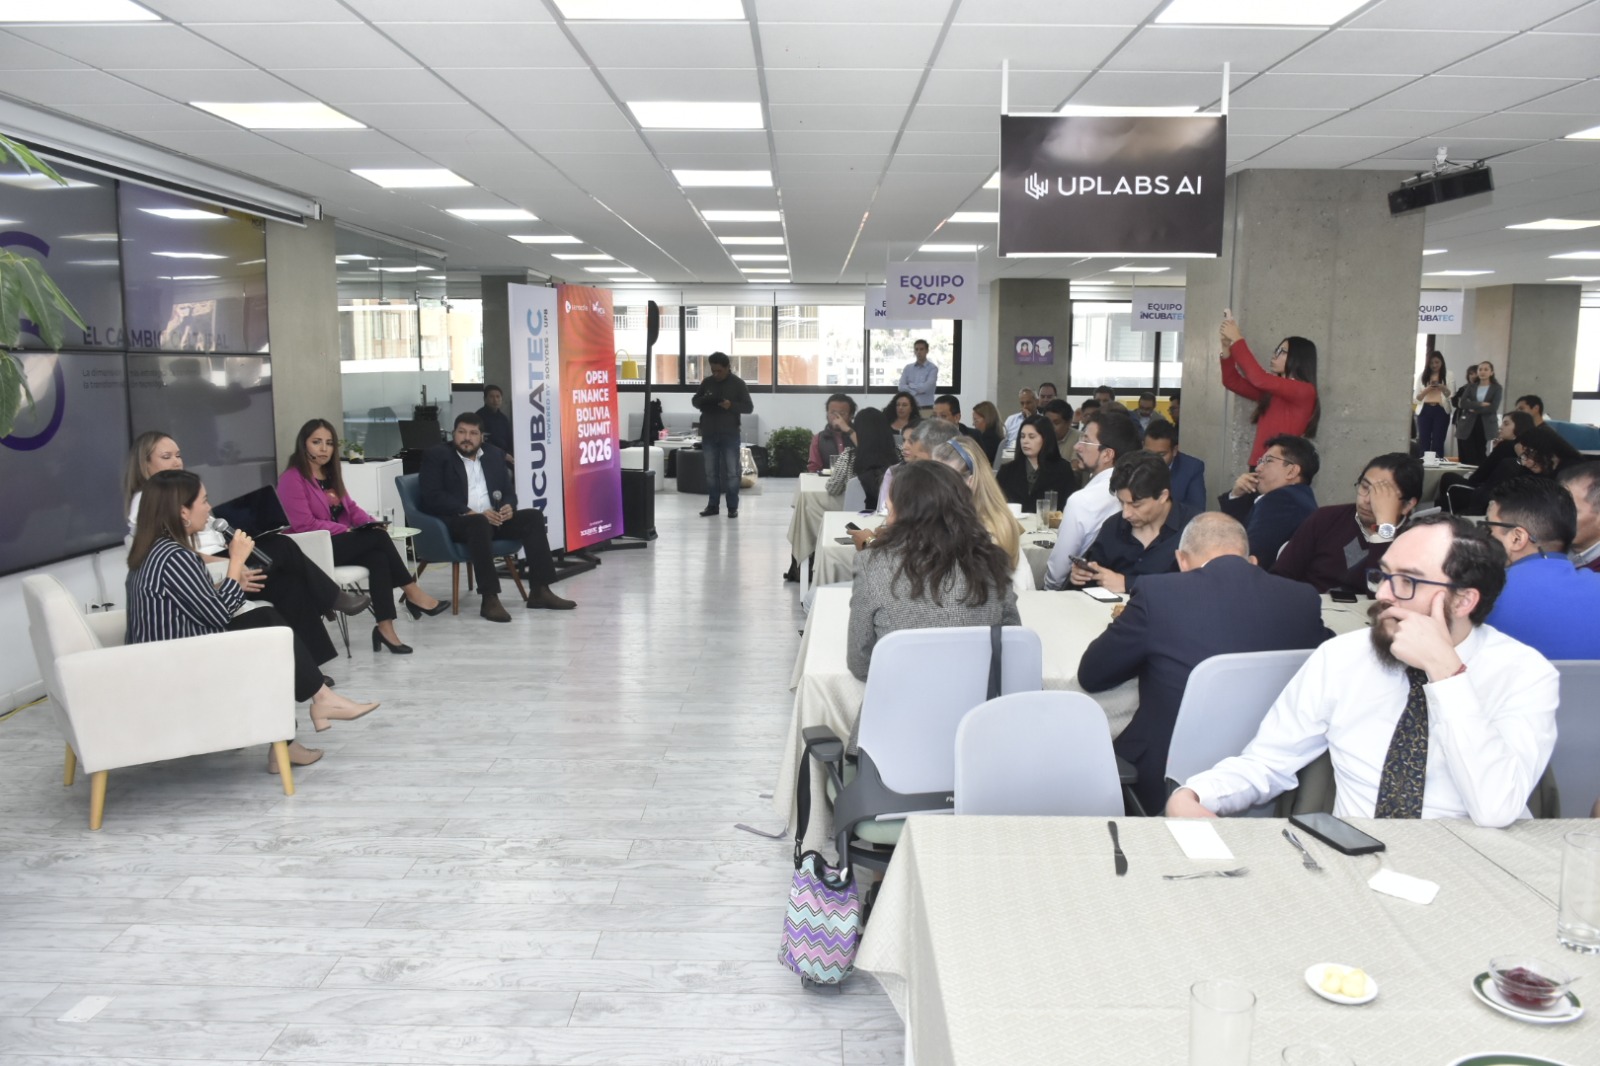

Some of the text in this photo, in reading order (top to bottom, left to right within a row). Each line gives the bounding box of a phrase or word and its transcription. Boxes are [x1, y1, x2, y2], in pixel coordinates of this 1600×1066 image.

[1057, 175, 1203, 196] UPLABS AI
[900, 274, 965, 290] EQUIPO
[916, 292, 948, 306] BCP
[1147, 302, 1183, 312] EQUIPO
[1418, 305, 1448, 314] QUIPO
[585, 370, 609, 385] OPEN
[572, 388, 609, 404] FINANCE
[576, 406, 610, 422] BOLIVIA
[578, 421, 611, 438] SUMMIT
[579, 438, 612, 465] 2026
